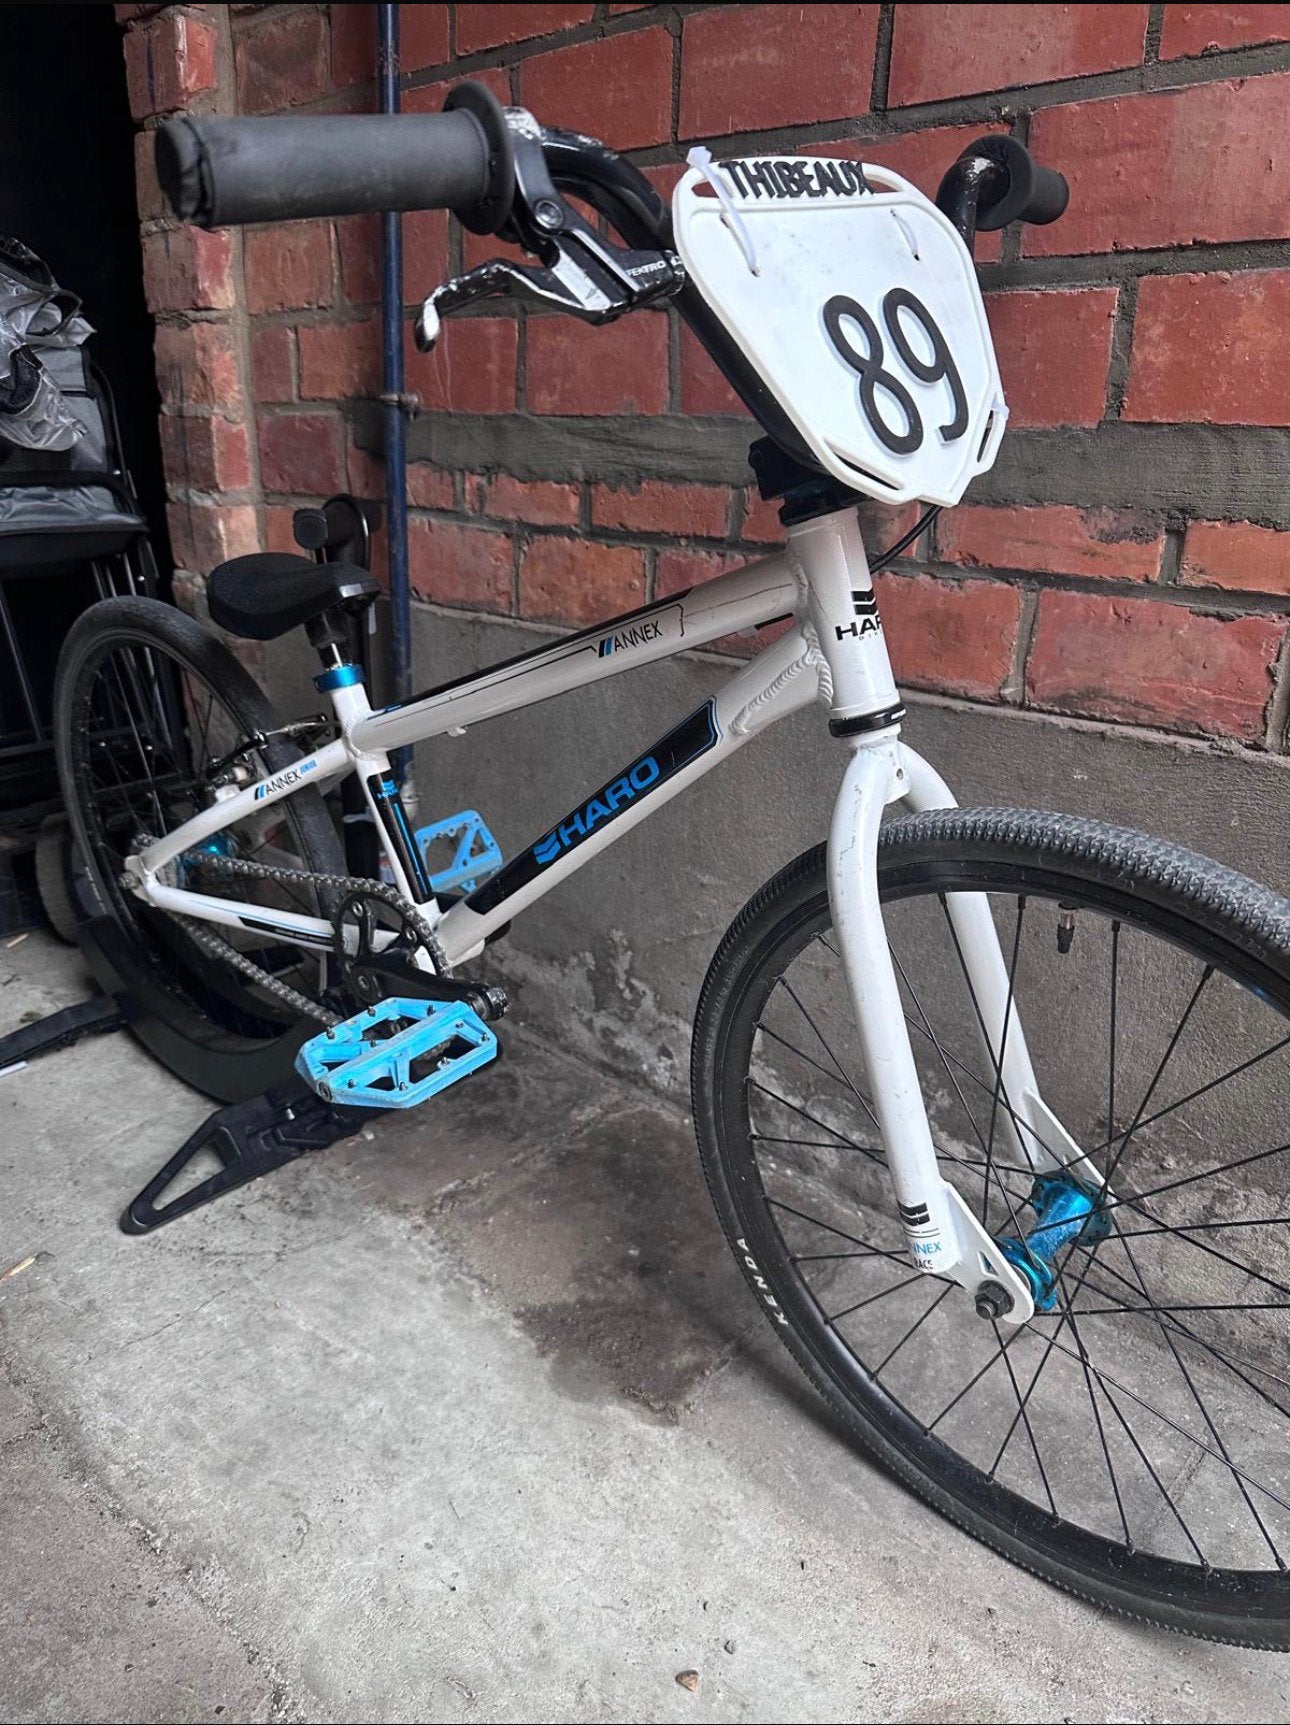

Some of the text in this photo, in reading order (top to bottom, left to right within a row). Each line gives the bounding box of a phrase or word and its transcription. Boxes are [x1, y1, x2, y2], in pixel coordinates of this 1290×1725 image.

[718, 160, 875, 199] THIBEAUX
[821, 287, 969, 455] 89
[613, 620, 664, 652] ANNEX
[265, 769, 302, 796] ANNEX
[557, 755, 660, 847] HARO
[736, 1237, 789, 1325] KENDA
